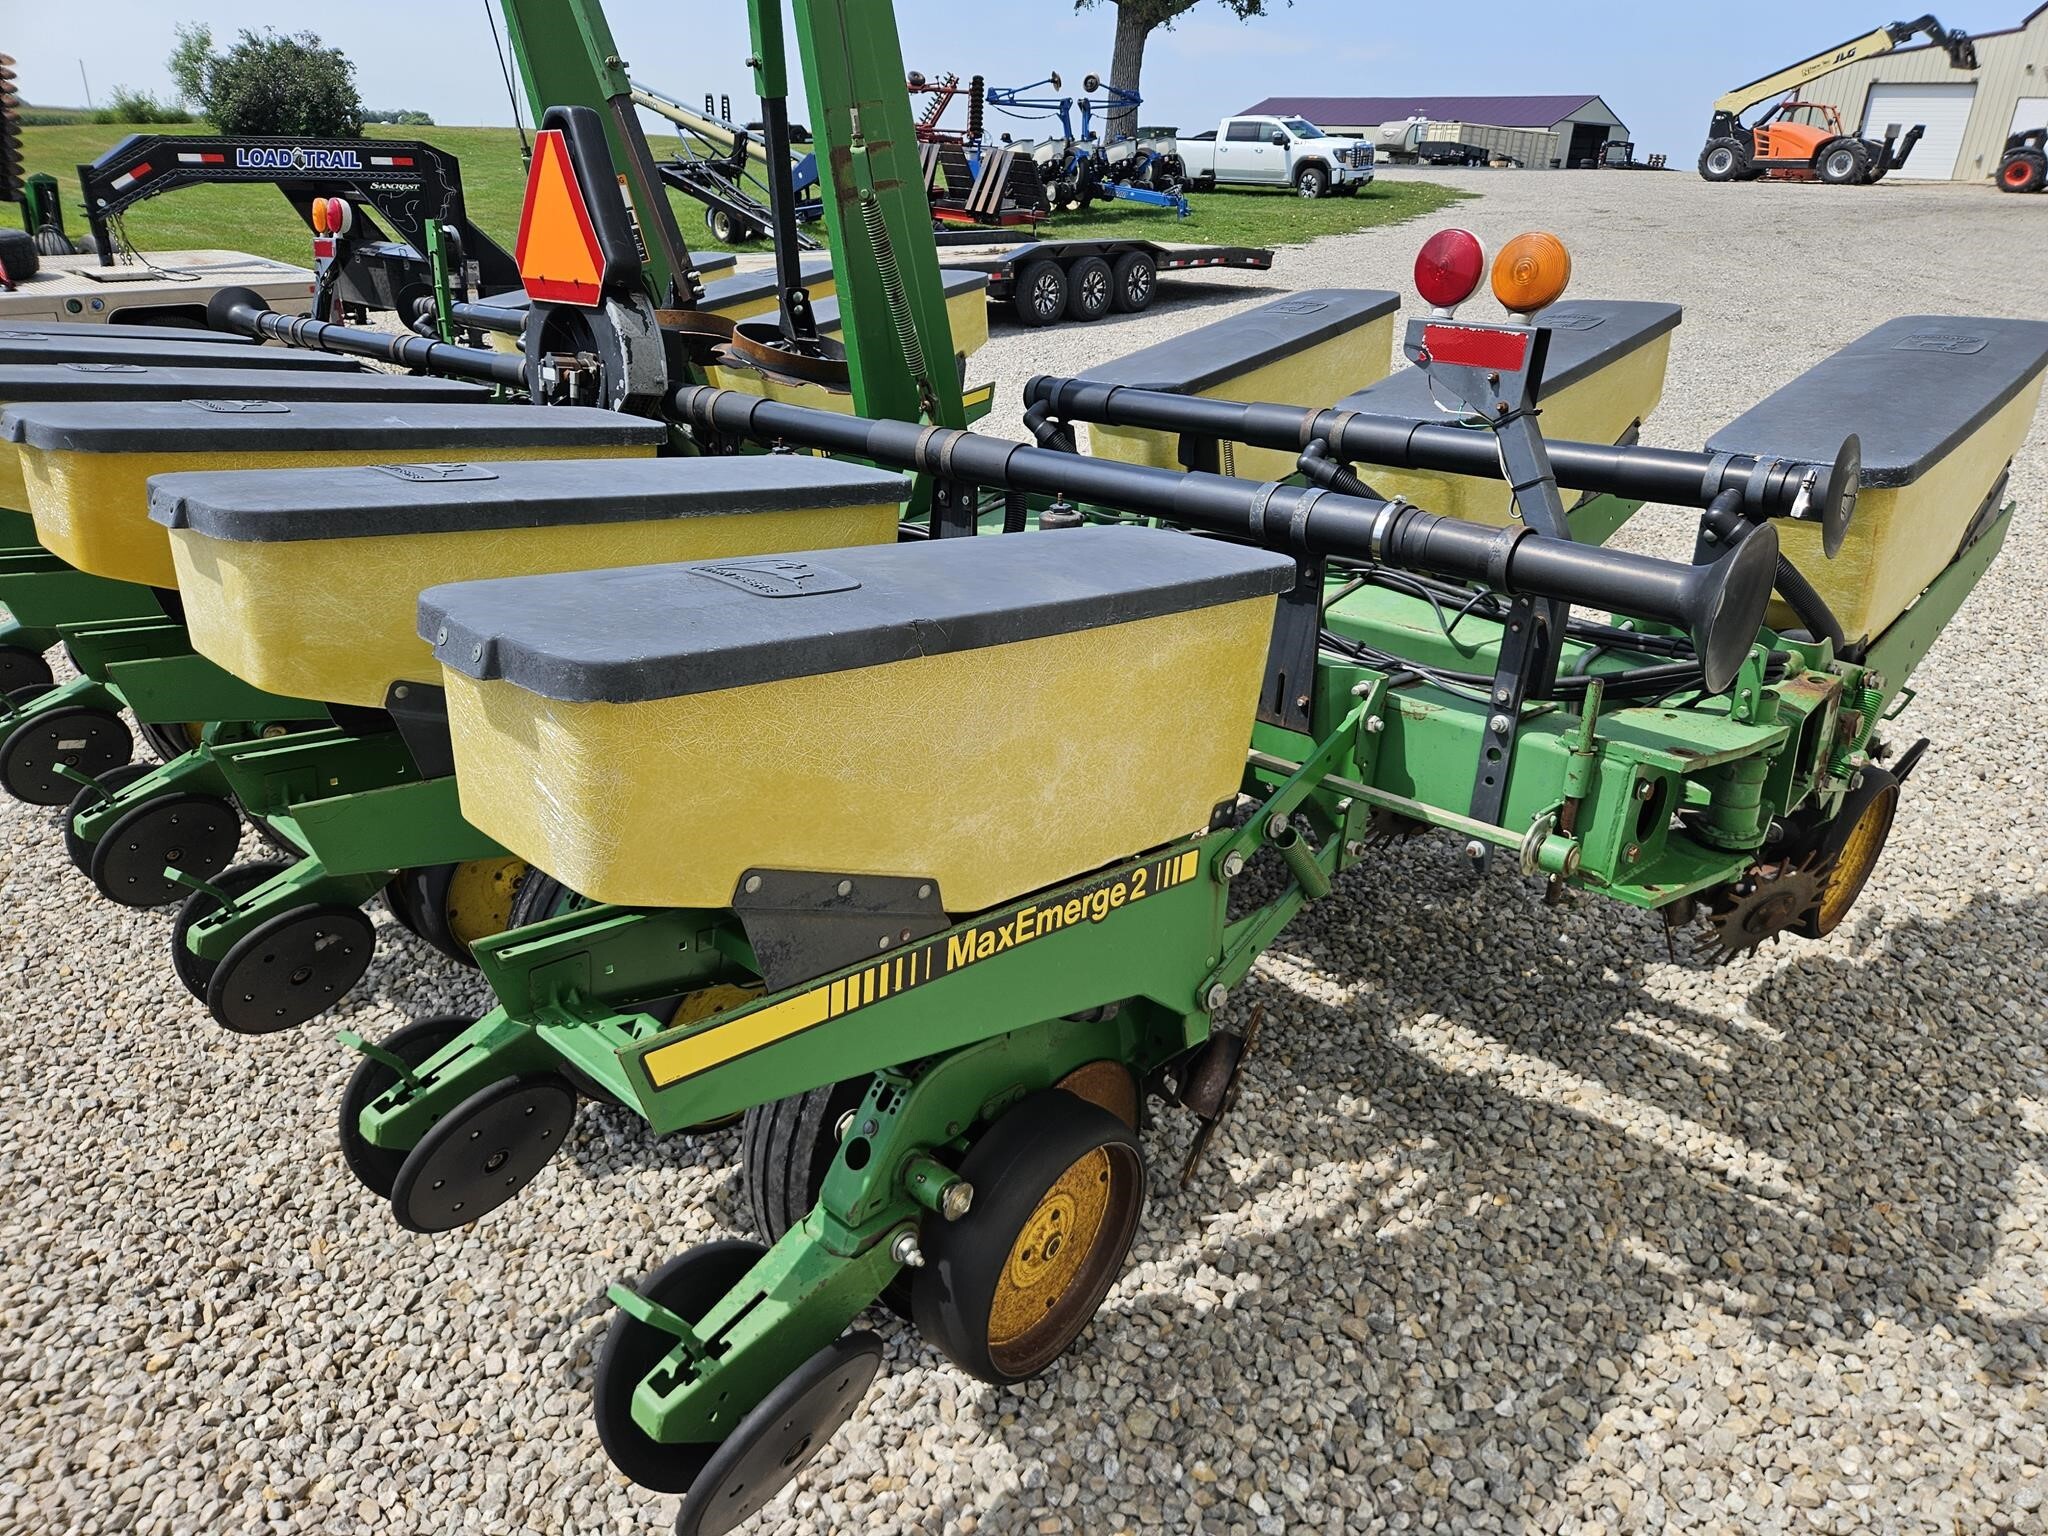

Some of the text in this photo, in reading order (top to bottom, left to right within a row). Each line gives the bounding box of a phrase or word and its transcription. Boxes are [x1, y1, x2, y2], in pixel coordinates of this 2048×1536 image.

[1832, 47, 1857, 64] JLG
[236, 148, 362, 169] LOAD TRAIL
[946, 867, 1148, 972] MaxEmerge 2
